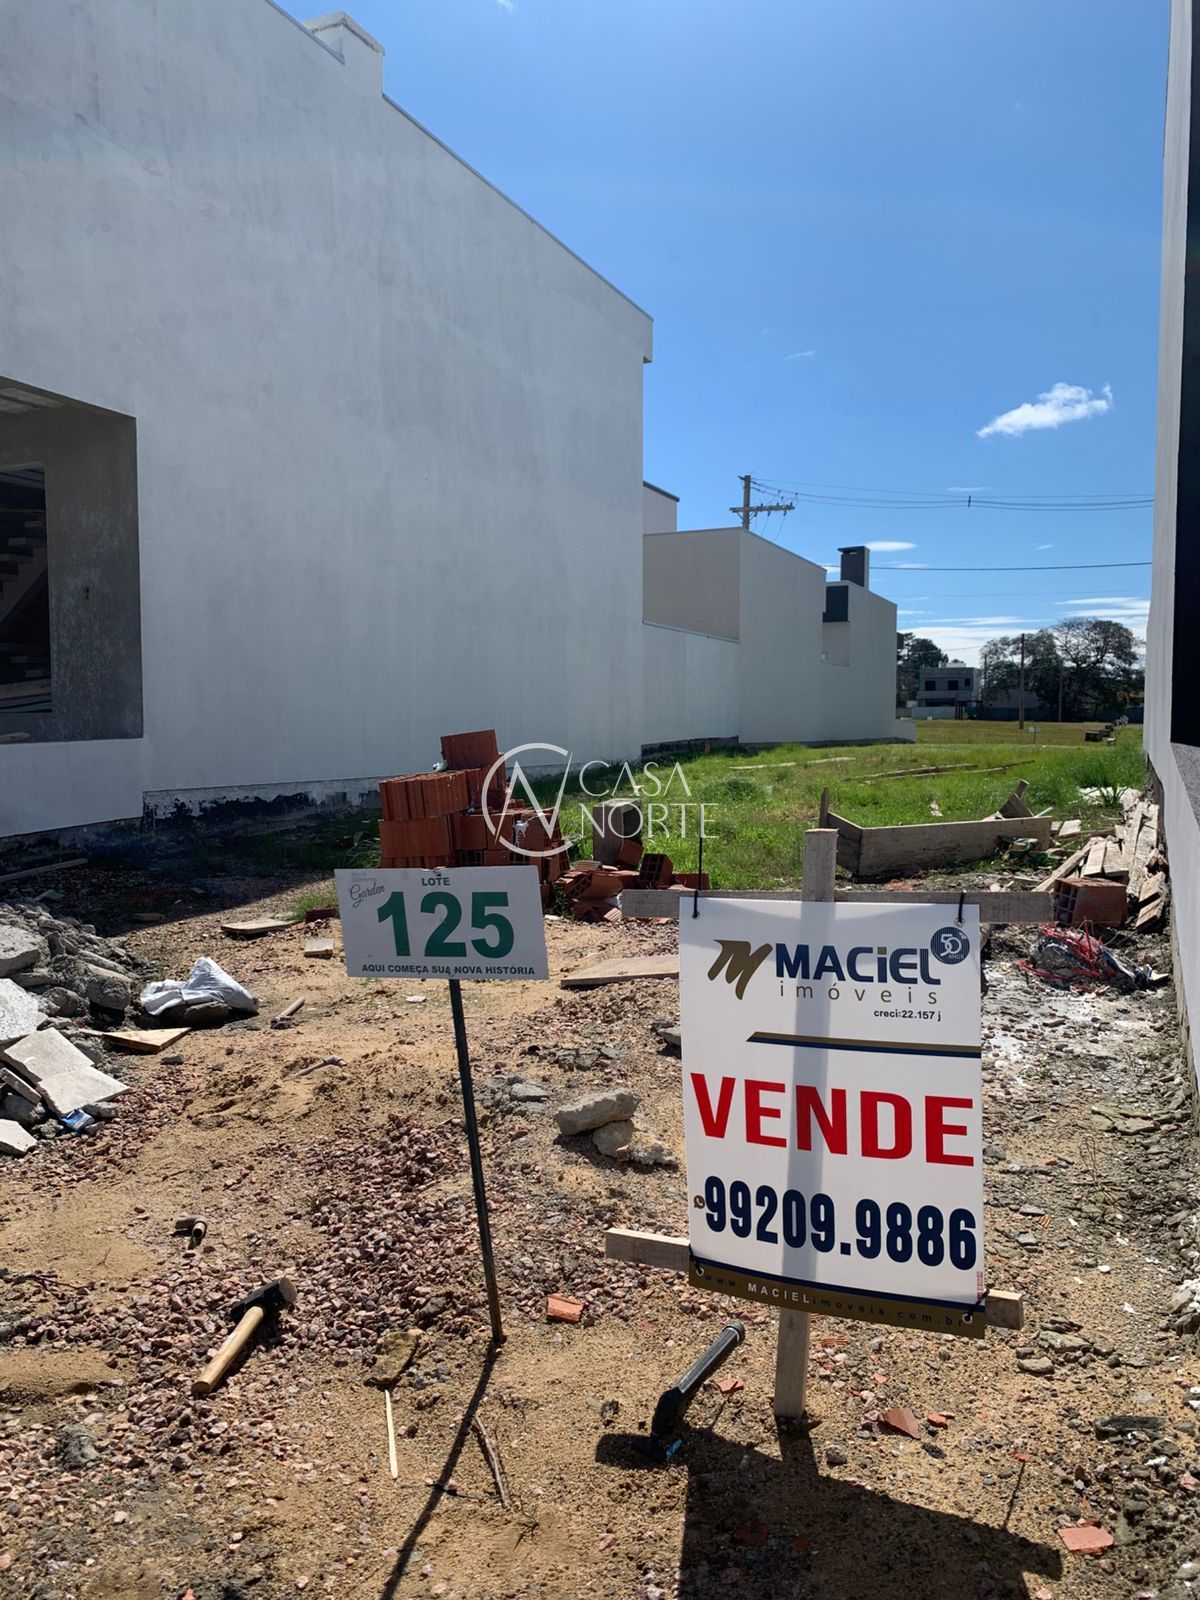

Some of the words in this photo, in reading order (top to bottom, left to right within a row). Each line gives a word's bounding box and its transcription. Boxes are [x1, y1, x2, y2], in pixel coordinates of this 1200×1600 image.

[421, 877, 450, 886] LOTE
[377, 891, 514, 958] 125
[362, 964, 385, 972] AQUI
[388, 964, 429, 973] COMEÇA
[431, 965, 452, 974] SUA
[454, 966, 482, 974] NOVA
[485, 965, 535, 975] HISTÓRIA
[780, 981, 938, 1004] imóveis
[690, 1072, 974, 1167] VENDE
[705, 1175, 977, 1270] 99209.9886
